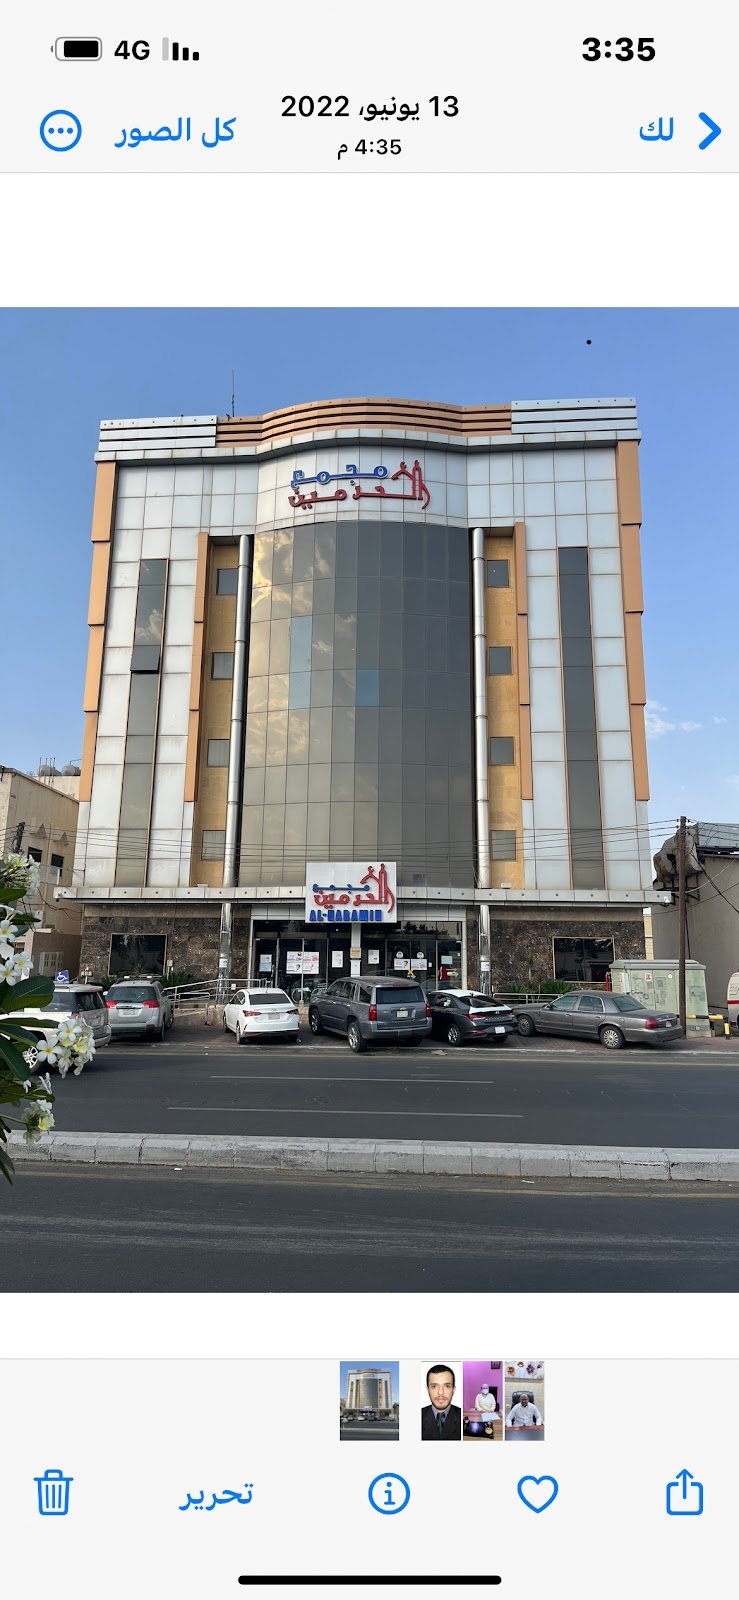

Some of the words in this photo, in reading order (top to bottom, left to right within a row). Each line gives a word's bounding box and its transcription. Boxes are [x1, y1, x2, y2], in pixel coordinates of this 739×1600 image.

[114, 40, 150, 60] 4G
[582, 37, 655, 61] 3:35
[282, 95, 349, 117] 2022
[359, 96, 420, 121] يونيو،
[429, 96, 459, 117] 13
[114, 117, 191, 148] الصور
[202, 117, 236, 148] كل
[639, 117, 674, 141] لك
[338, 144, 348, 160] م
[355, 139, 401, 155] 4:35
[288, 459, 431, 510] الحرمين
[291, 464, 388, 488] مجمع
[312, 883, 370, 895] مجمع
[313, 863, 395, 913] الحرمين
[179, 1483, 254, 1511] تحرير
